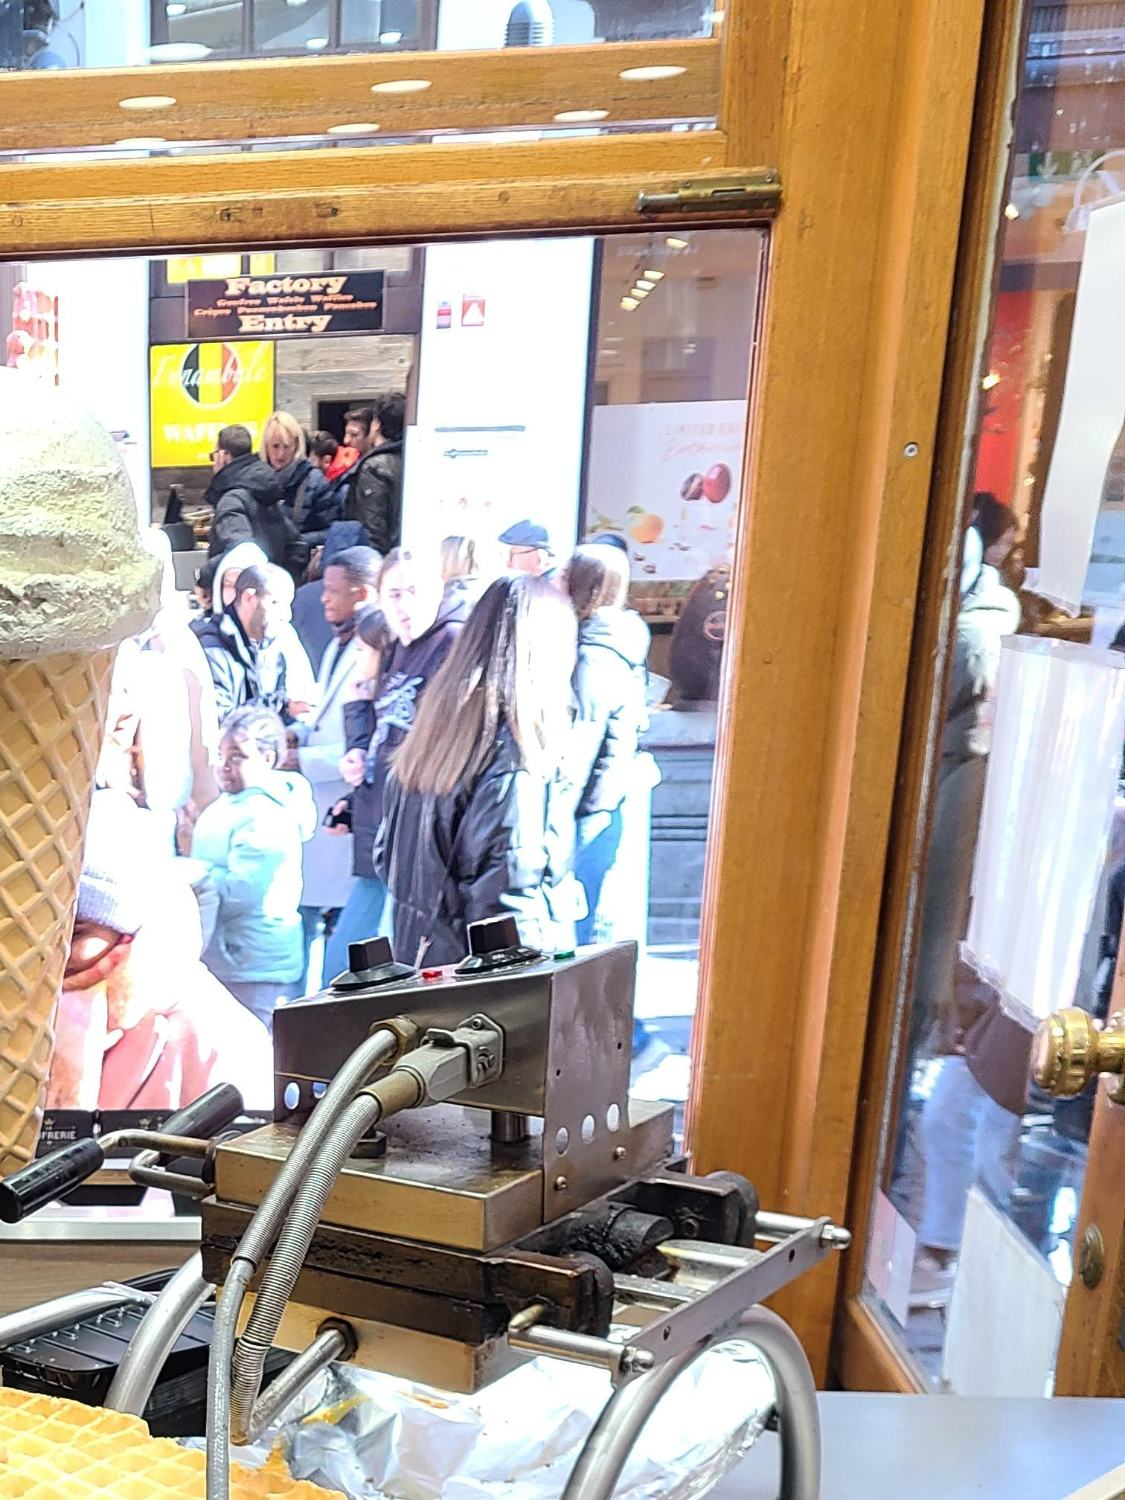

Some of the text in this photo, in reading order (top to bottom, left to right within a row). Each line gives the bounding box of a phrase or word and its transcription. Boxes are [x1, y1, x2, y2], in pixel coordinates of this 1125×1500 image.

[224, 276, 348, 296] Factory
[237, 314, 333, 333] Entry
[39, 1130, 77, 1140] FRERIE
